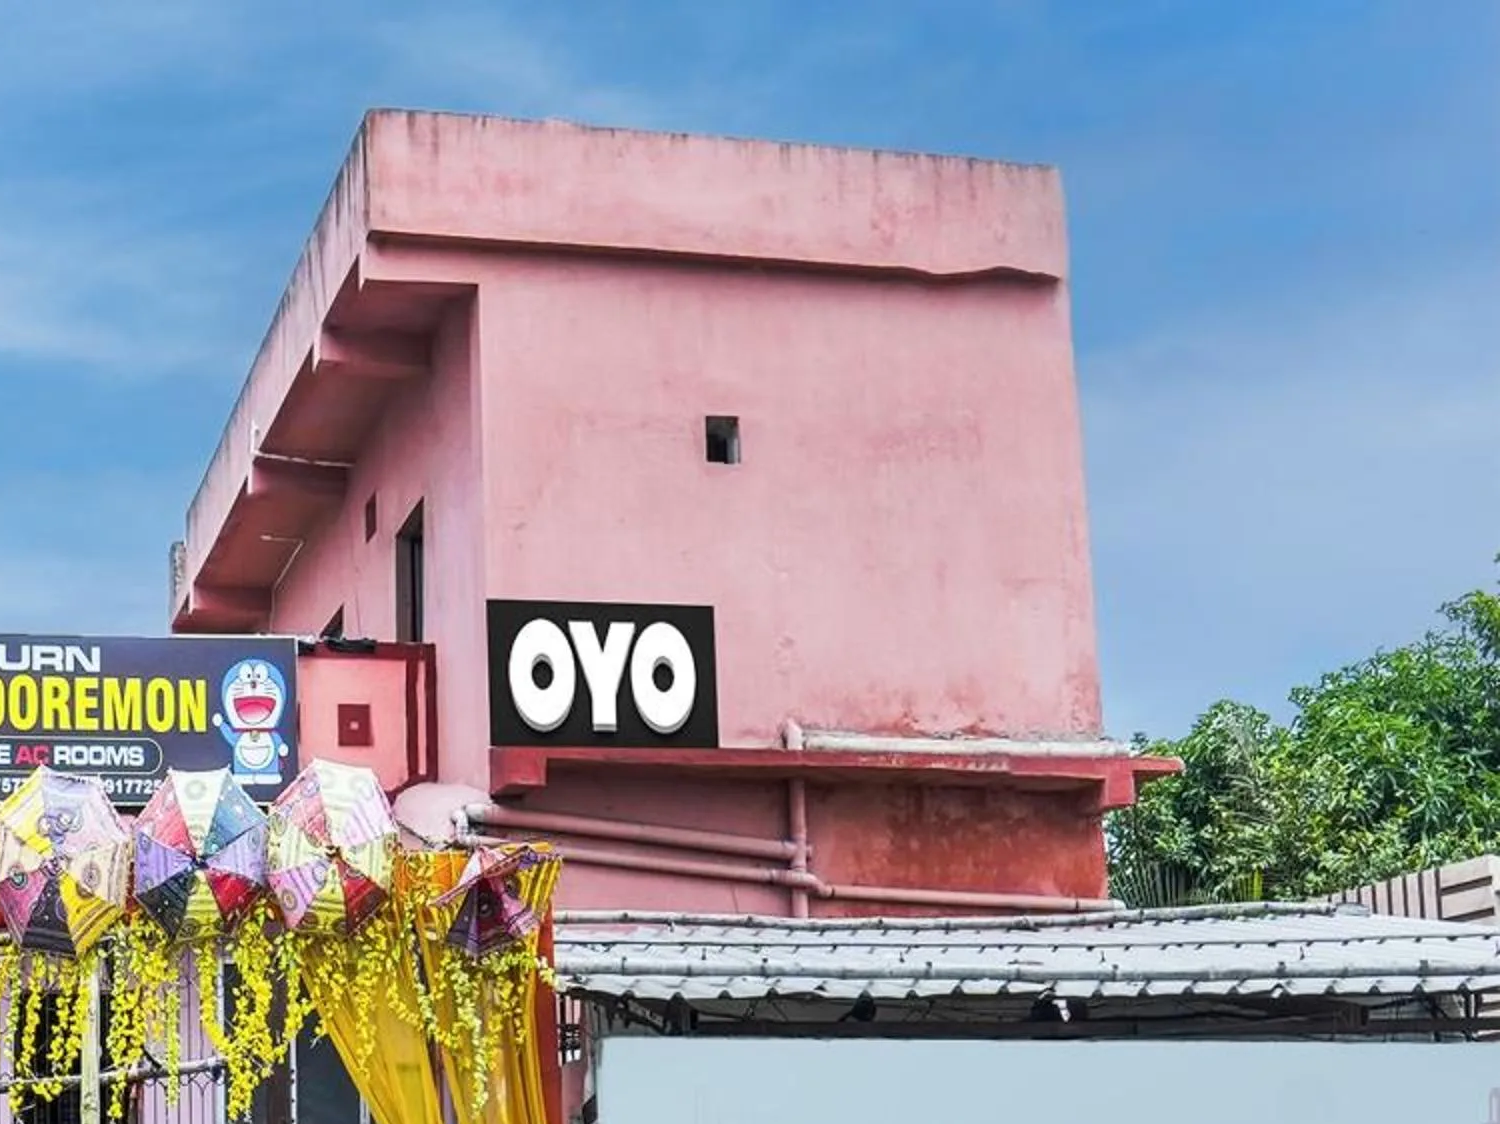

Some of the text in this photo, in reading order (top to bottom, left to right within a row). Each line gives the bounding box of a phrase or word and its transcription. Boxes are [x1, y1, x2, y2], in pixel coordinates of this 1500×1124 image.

[509, 618, 697, 735] OYO
[14, 747, 49, 765] AC
[53, 746, 145, 767] ROOMS
